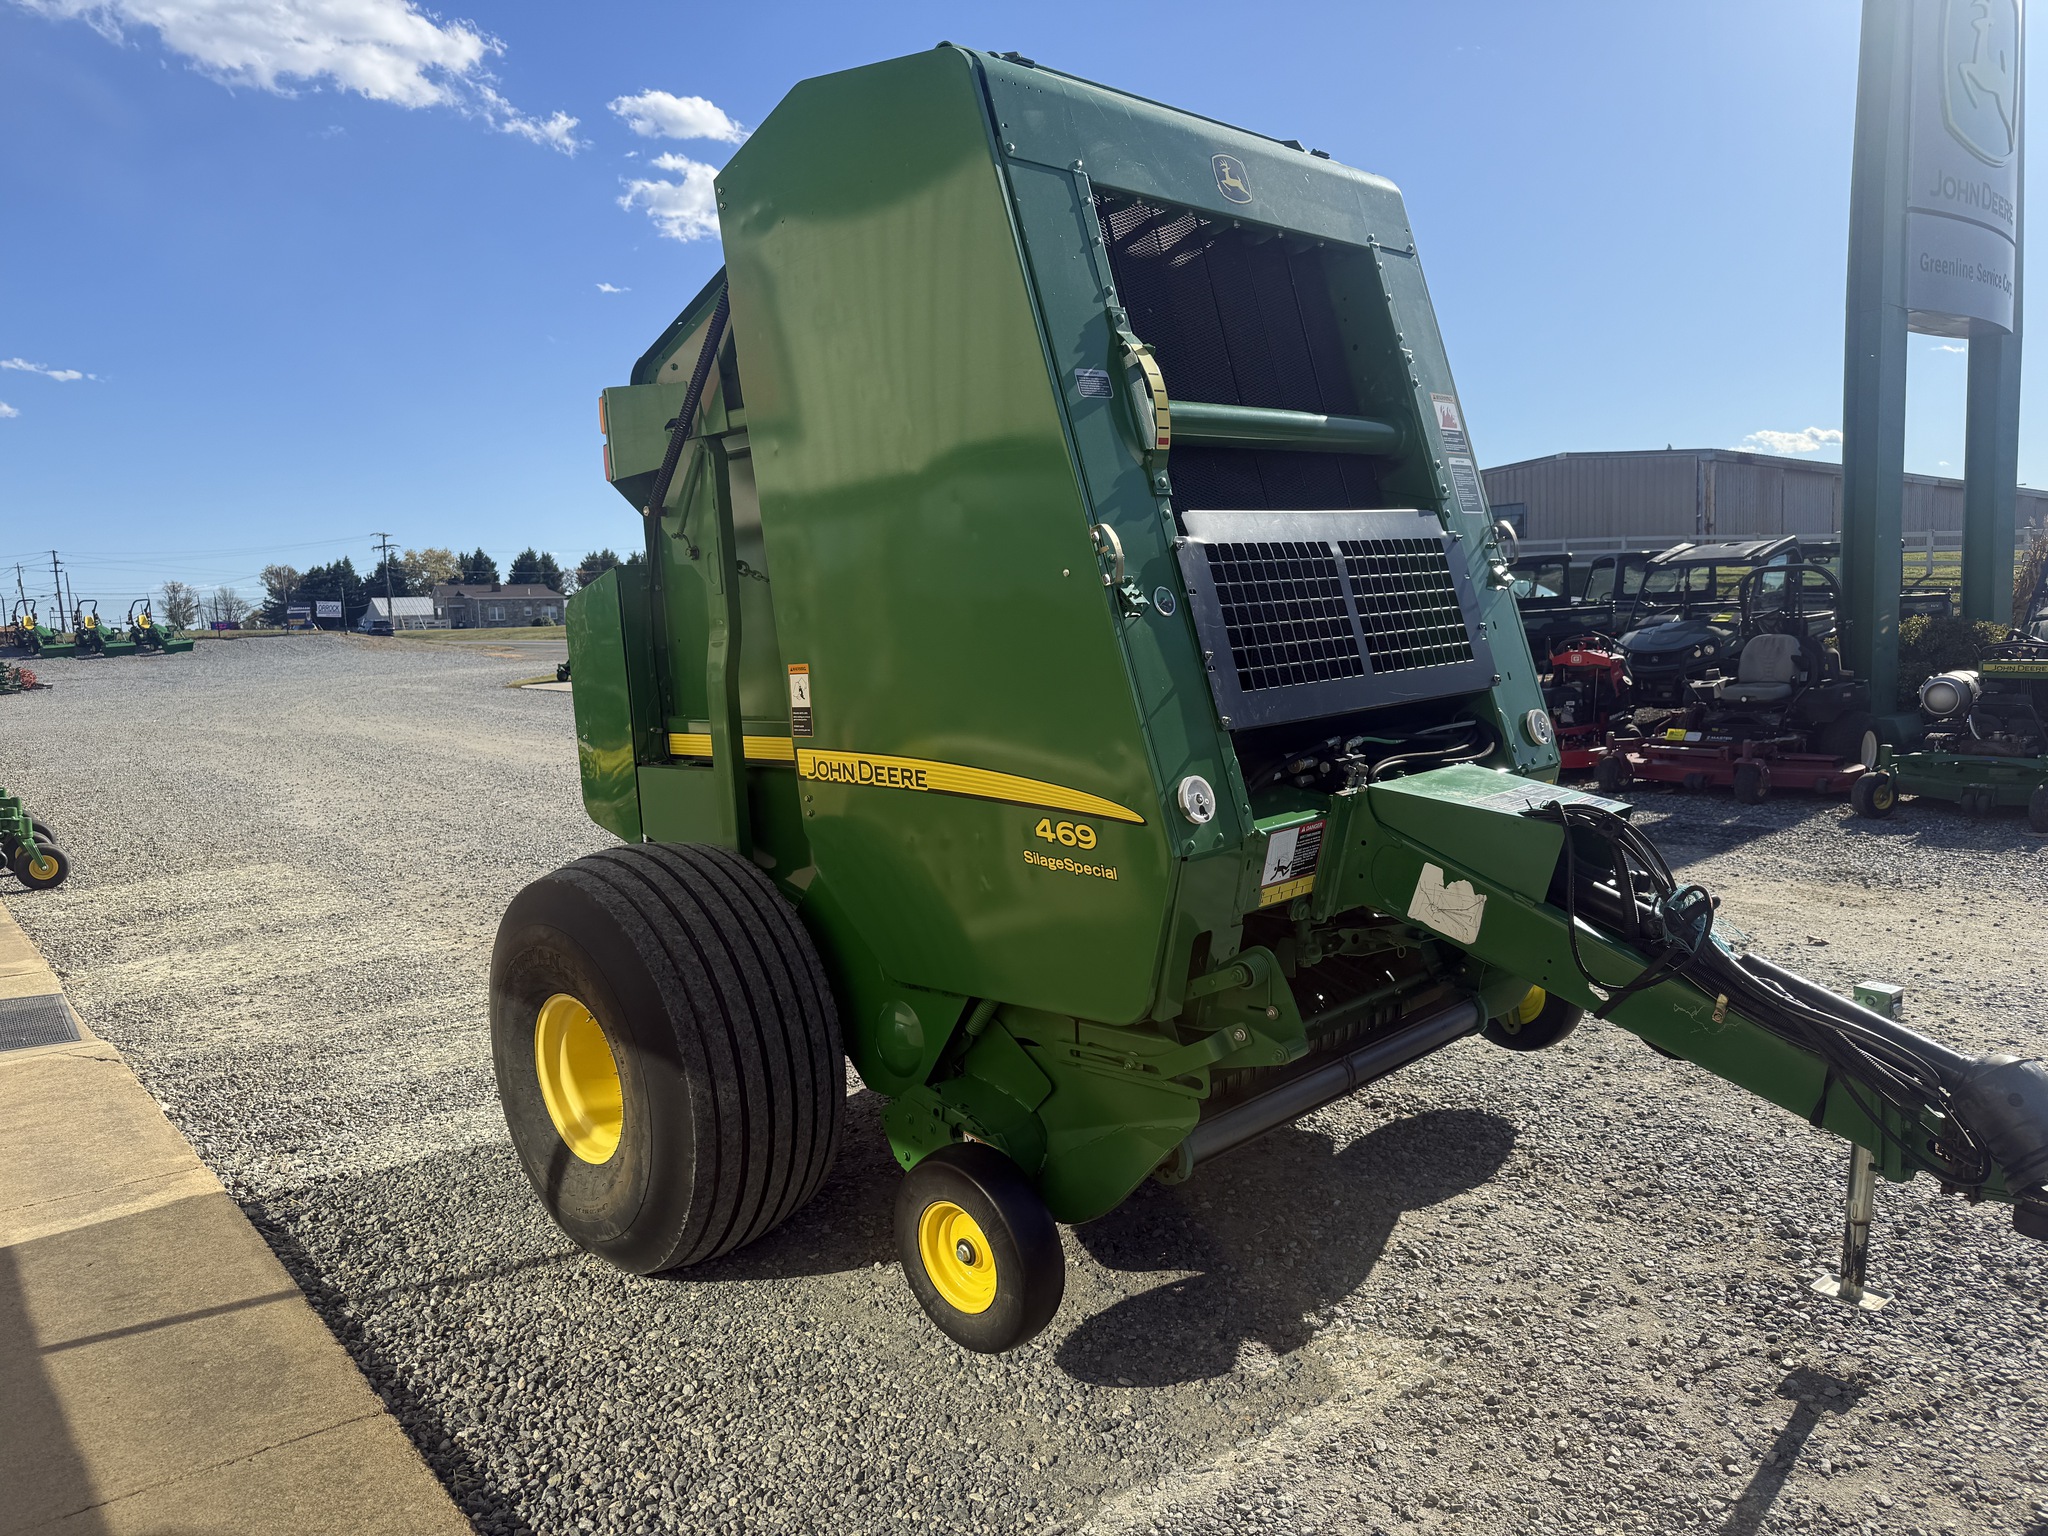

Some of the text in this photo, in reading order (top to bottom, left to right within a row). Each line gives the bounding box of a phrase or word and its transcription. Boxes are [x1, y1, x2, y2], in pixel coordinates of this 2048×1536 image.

[1930, 169, 2013, 226] JOHN DEERE
[1920, 252, 1973, 279] Greenline
[1976, 263, 2001, 288] Service
[807, 757, 928, 788] JOHN DEERE
[1035, 818, 1097, 850] 469
[1023, 850, 1118, 881] SilageSpecial
